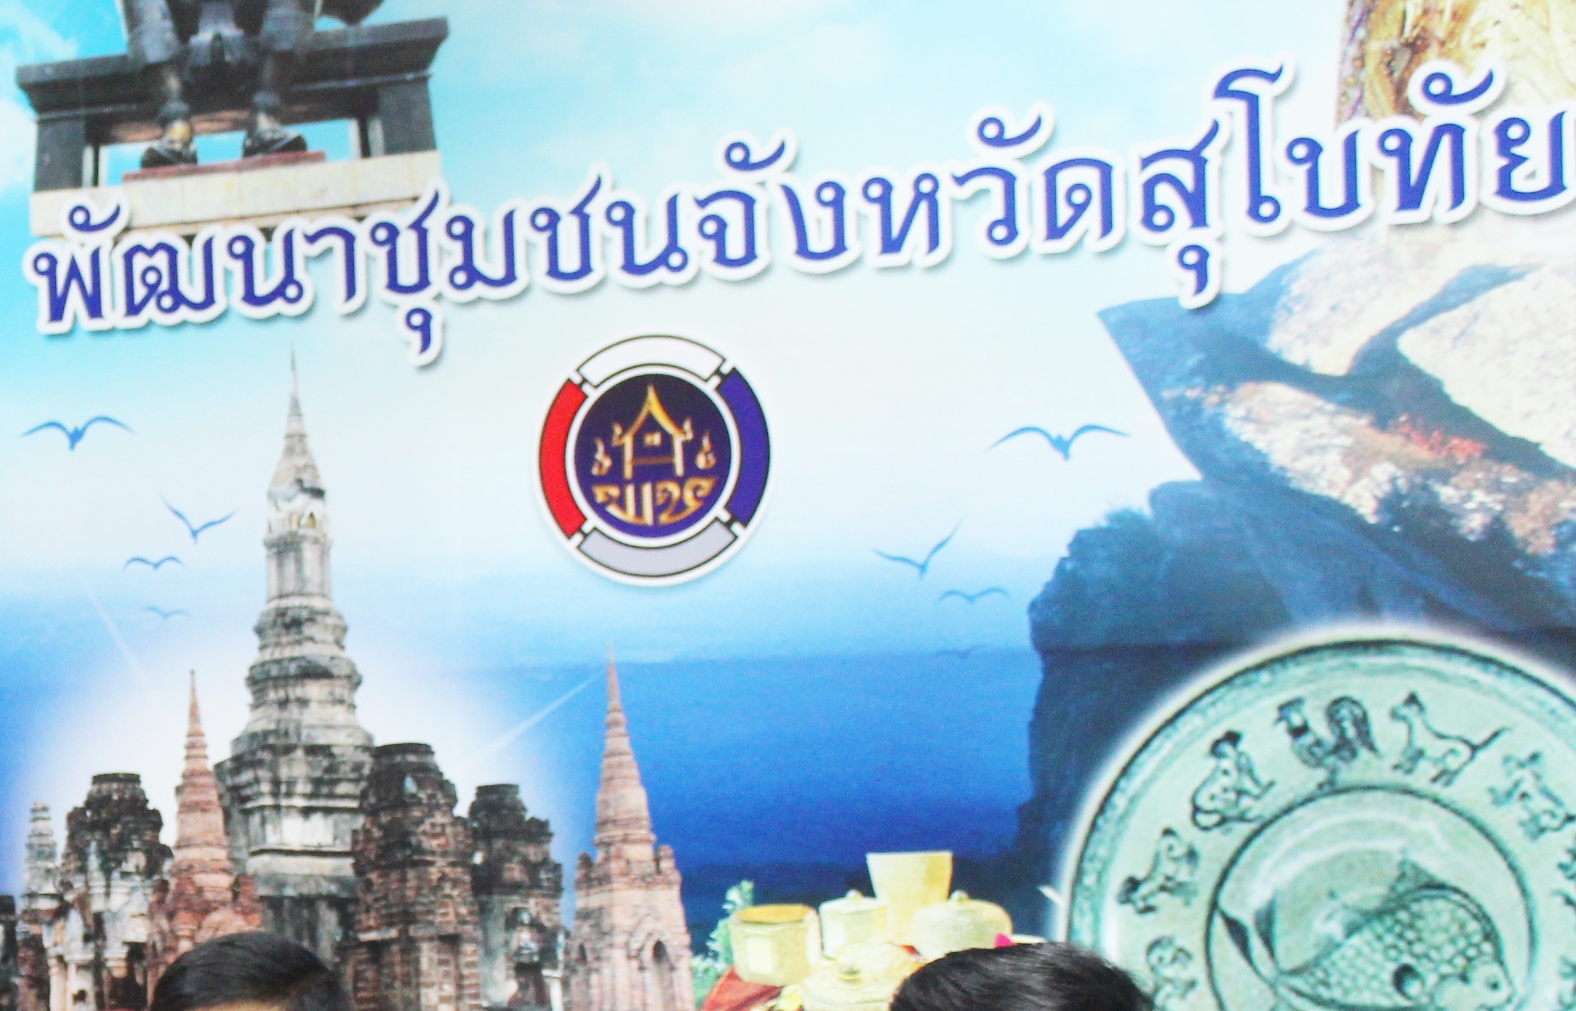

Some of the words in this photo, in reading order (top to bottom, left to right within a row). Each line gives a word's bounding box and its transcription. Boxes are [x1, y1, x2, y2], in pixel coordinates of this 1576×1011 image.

[32, 62, 1569, 355] พัฒนาชุมชนจังหวัดสุโขทัย
